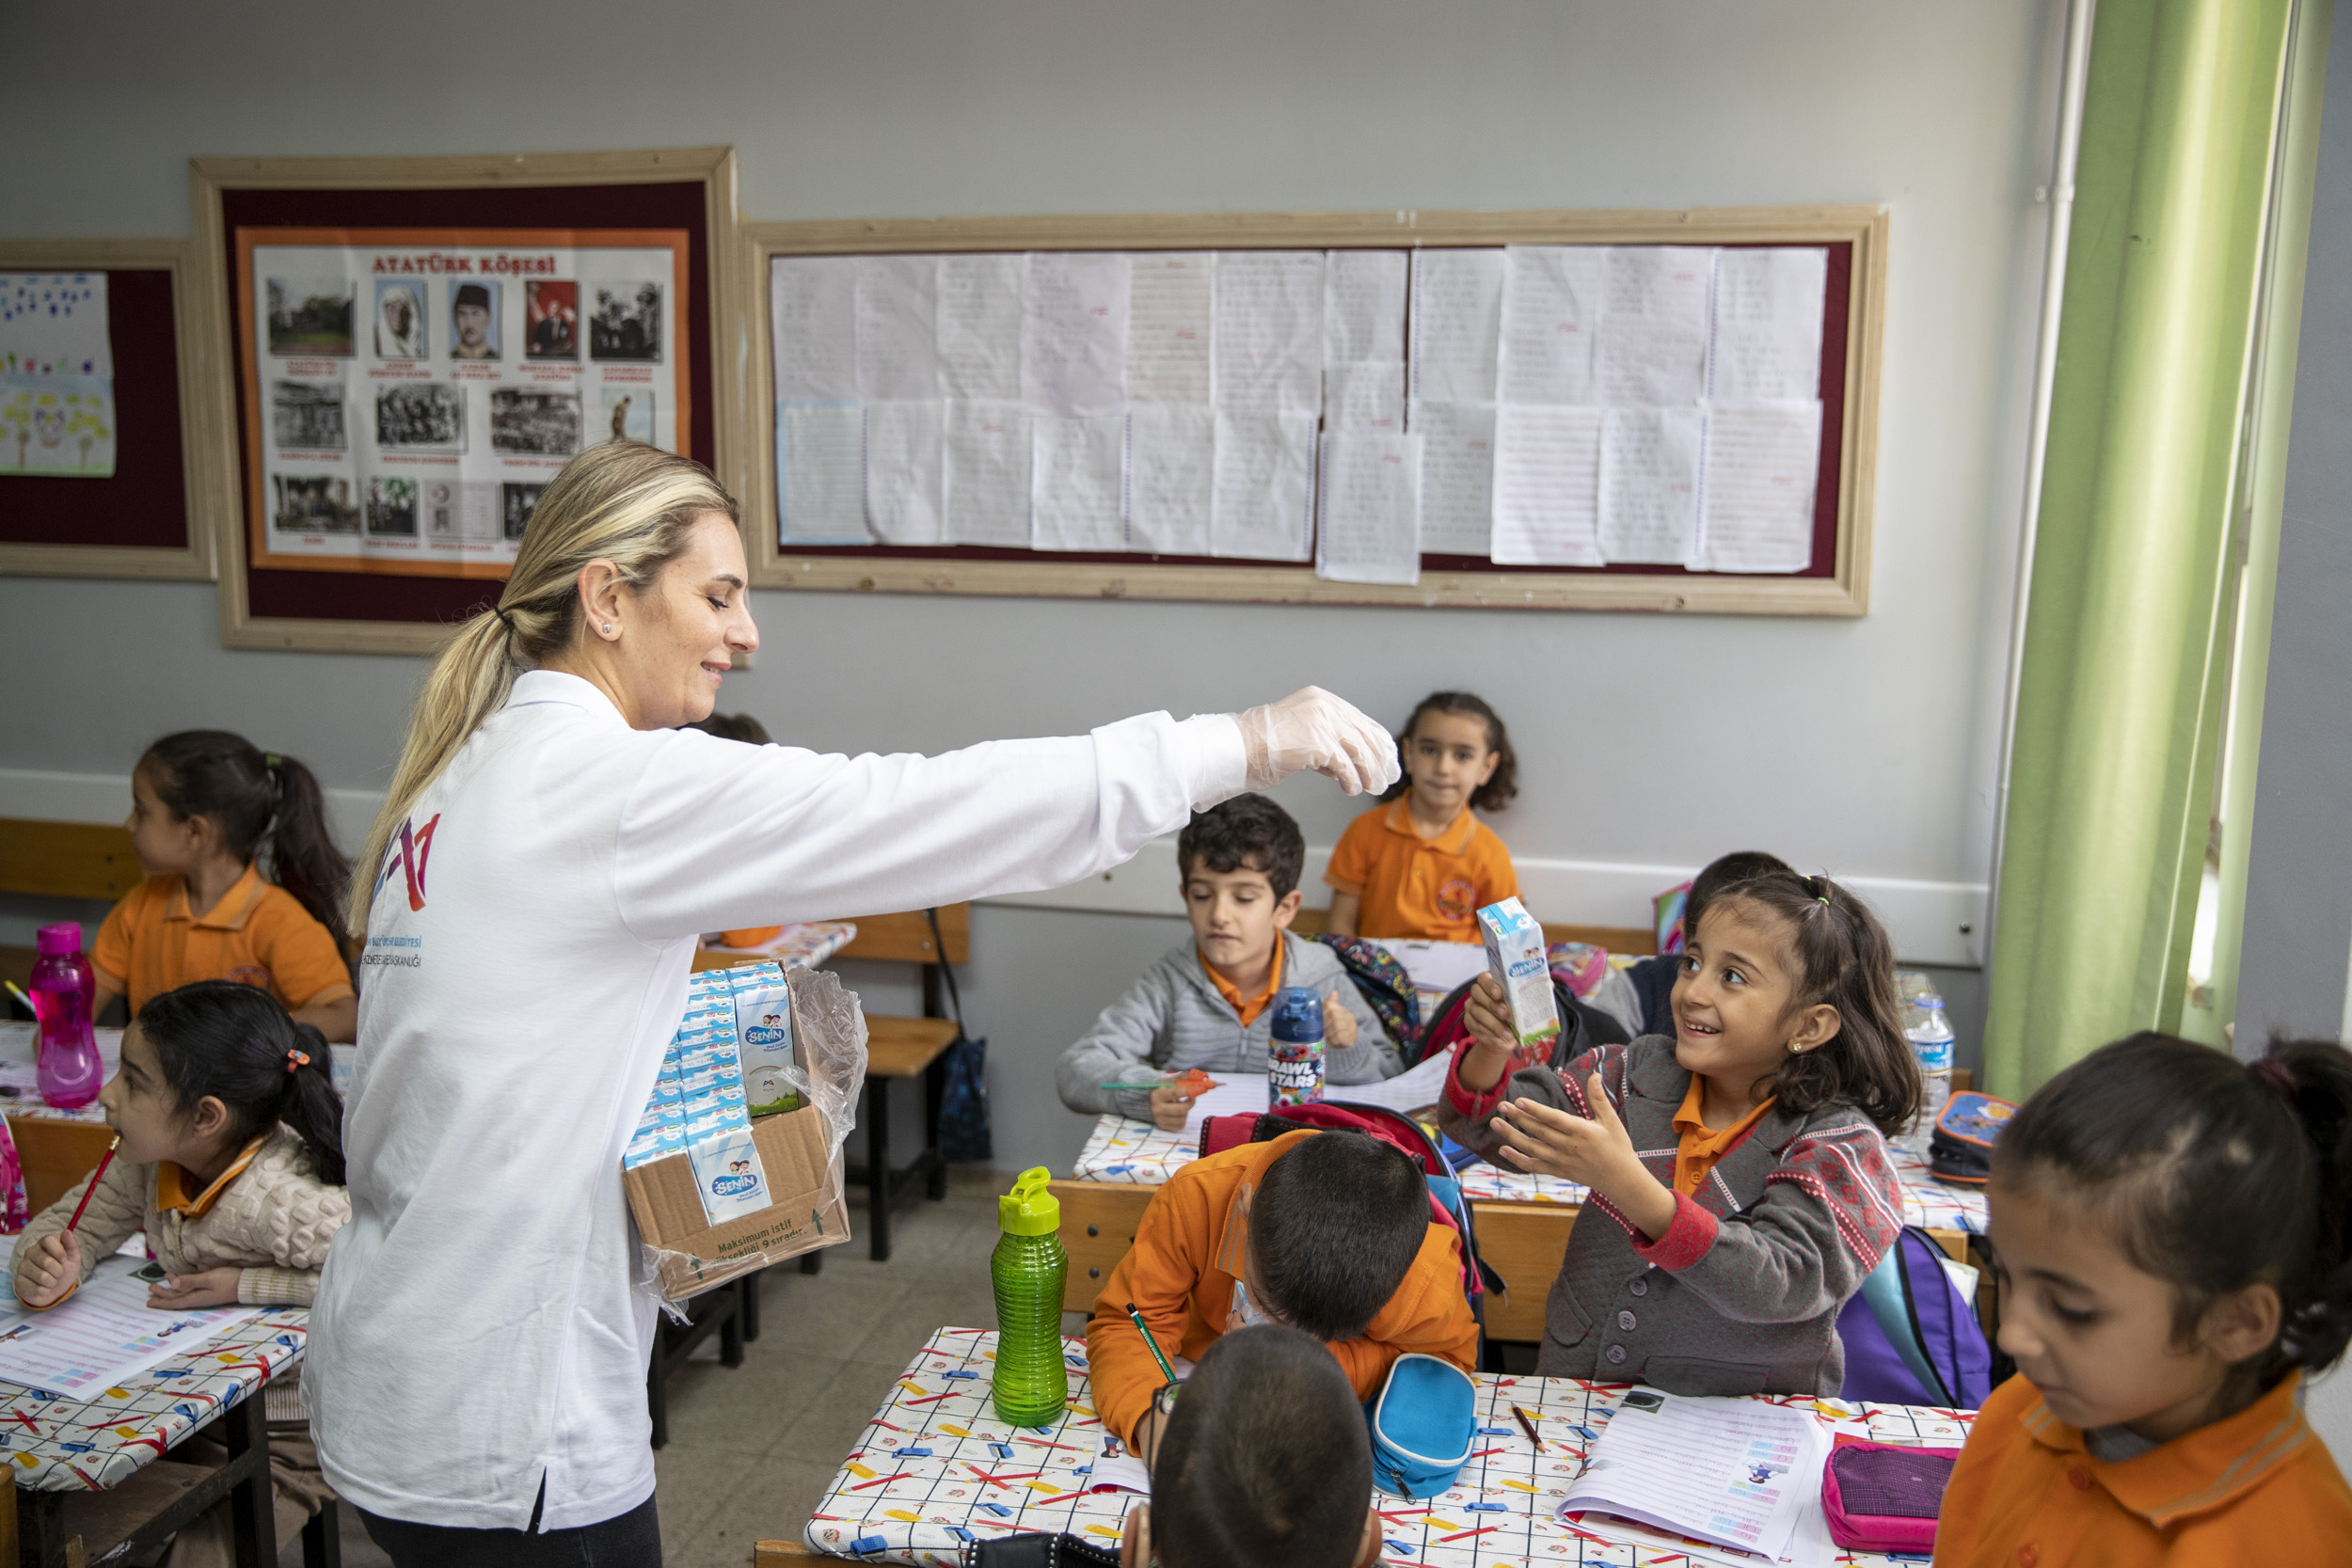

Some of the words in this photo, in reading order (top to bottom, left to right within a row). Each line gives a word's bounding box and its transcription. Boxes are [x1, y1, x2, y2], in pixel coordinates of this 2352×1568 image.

[373, 253, 472, 274] ATATÜRK
[480, 253, 557, 277] KÖŞESİ
[749, 1028, 783, 1043] SENİN
[1270, 1071, 1317, 1088] STARS
[716, 1176, 755, 1195] SENİN
[718, 1228, 770, 1253] Maksimum
[771, 1218, 792, 1234] istif
[762, 1240, 770, 1248] 9
